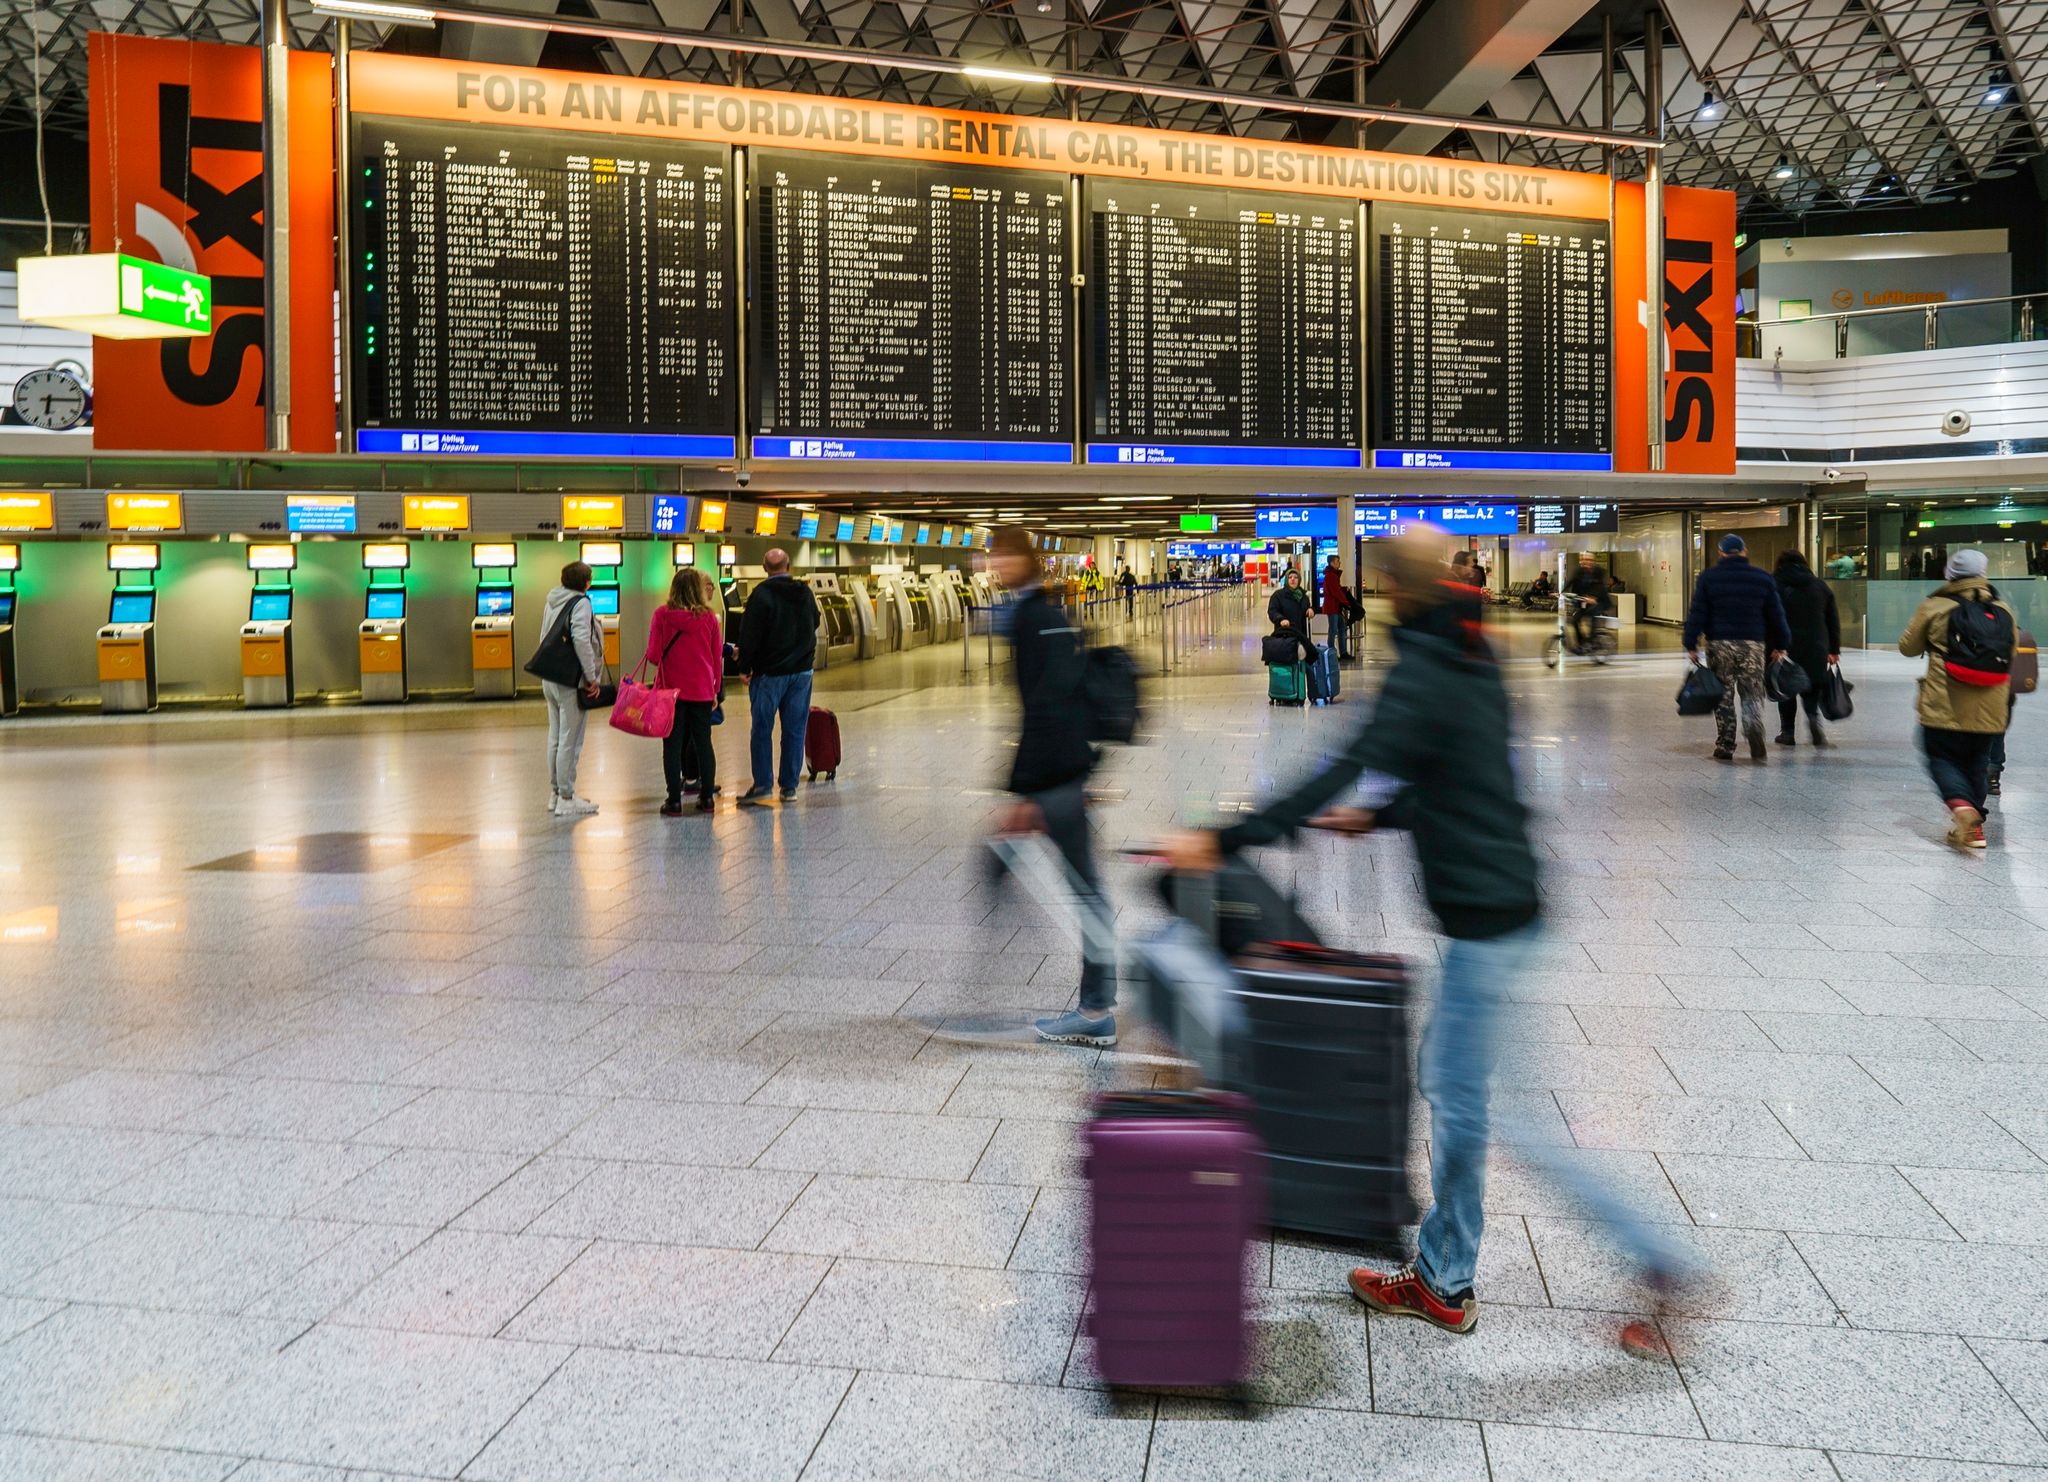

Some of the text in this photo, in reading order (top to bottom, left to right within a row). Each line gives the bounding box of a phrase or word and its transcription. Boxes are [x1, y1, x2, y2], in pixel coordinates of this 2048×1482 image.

[457, 72, 1553, 207] FOR AN AFFORDABLE RENTAL CAR, THE DESTINATION IS SIXT.
[446, 164, 516, 177] JOHANNESBURG
[446, 175, 527, 188] MADRID-BARAJAS
[447, 195, 539, 209] LONDON-CANCELLED
[447, 206, 476, 215] PARIS
[506, 209, 516, 217] DE
[523, 210, 556, 220] GAULLE
[447, 216, 482, 225] BERLIN
[488, 219, 545, 229] HBF-ERFURT
[447, 226, 562, 240] AACHEN HBF-KOELN HBF
[139, 83, 263, 406] SIXT
[448, 237, 540, 249] BERLIN-CANCELLED
[448, 247, 557, 260] AMSTERDAM-CANCELLED
[448, 257, 494, 267] WARSCHAU
[448, 267, 471, 276] WIEN
[448, 288, 500, 297] AMSTERDAM
[448, 309, 558, 320] NUERNBERG-CANCELLED
[449, 320, 558, 331] STOCKHOLM-CANCELLED
[449, 330, 512, 338] LONDON-CITY
[449, 340, 536, 350] OSLO-GARDERMOEN
[450, 350, 536, 360] LONDON-HEATHROW
[449, 360, 477, 368] PARIS
[508, 362, 517, 370] DE
[525, 363, 558, 371] GAULLE
[449, 371, 530, 380] DORTMUND-KOELN
[450, 402, 559, 411] BARCELONA-CANCELLED
[450, 412, 531, 420] GENF-CANCELLED
[441, 434, 465, 444] Abflug
[441, 443, 479, 453] Departures
[823, 441, 843, 450] Abflug
[823, 450, 855, 458] Departures
[1301, 510, 1309, 521] C
[1390, 510, 1397, 520] B
[1476, 508, 1494, 520] A,Z
